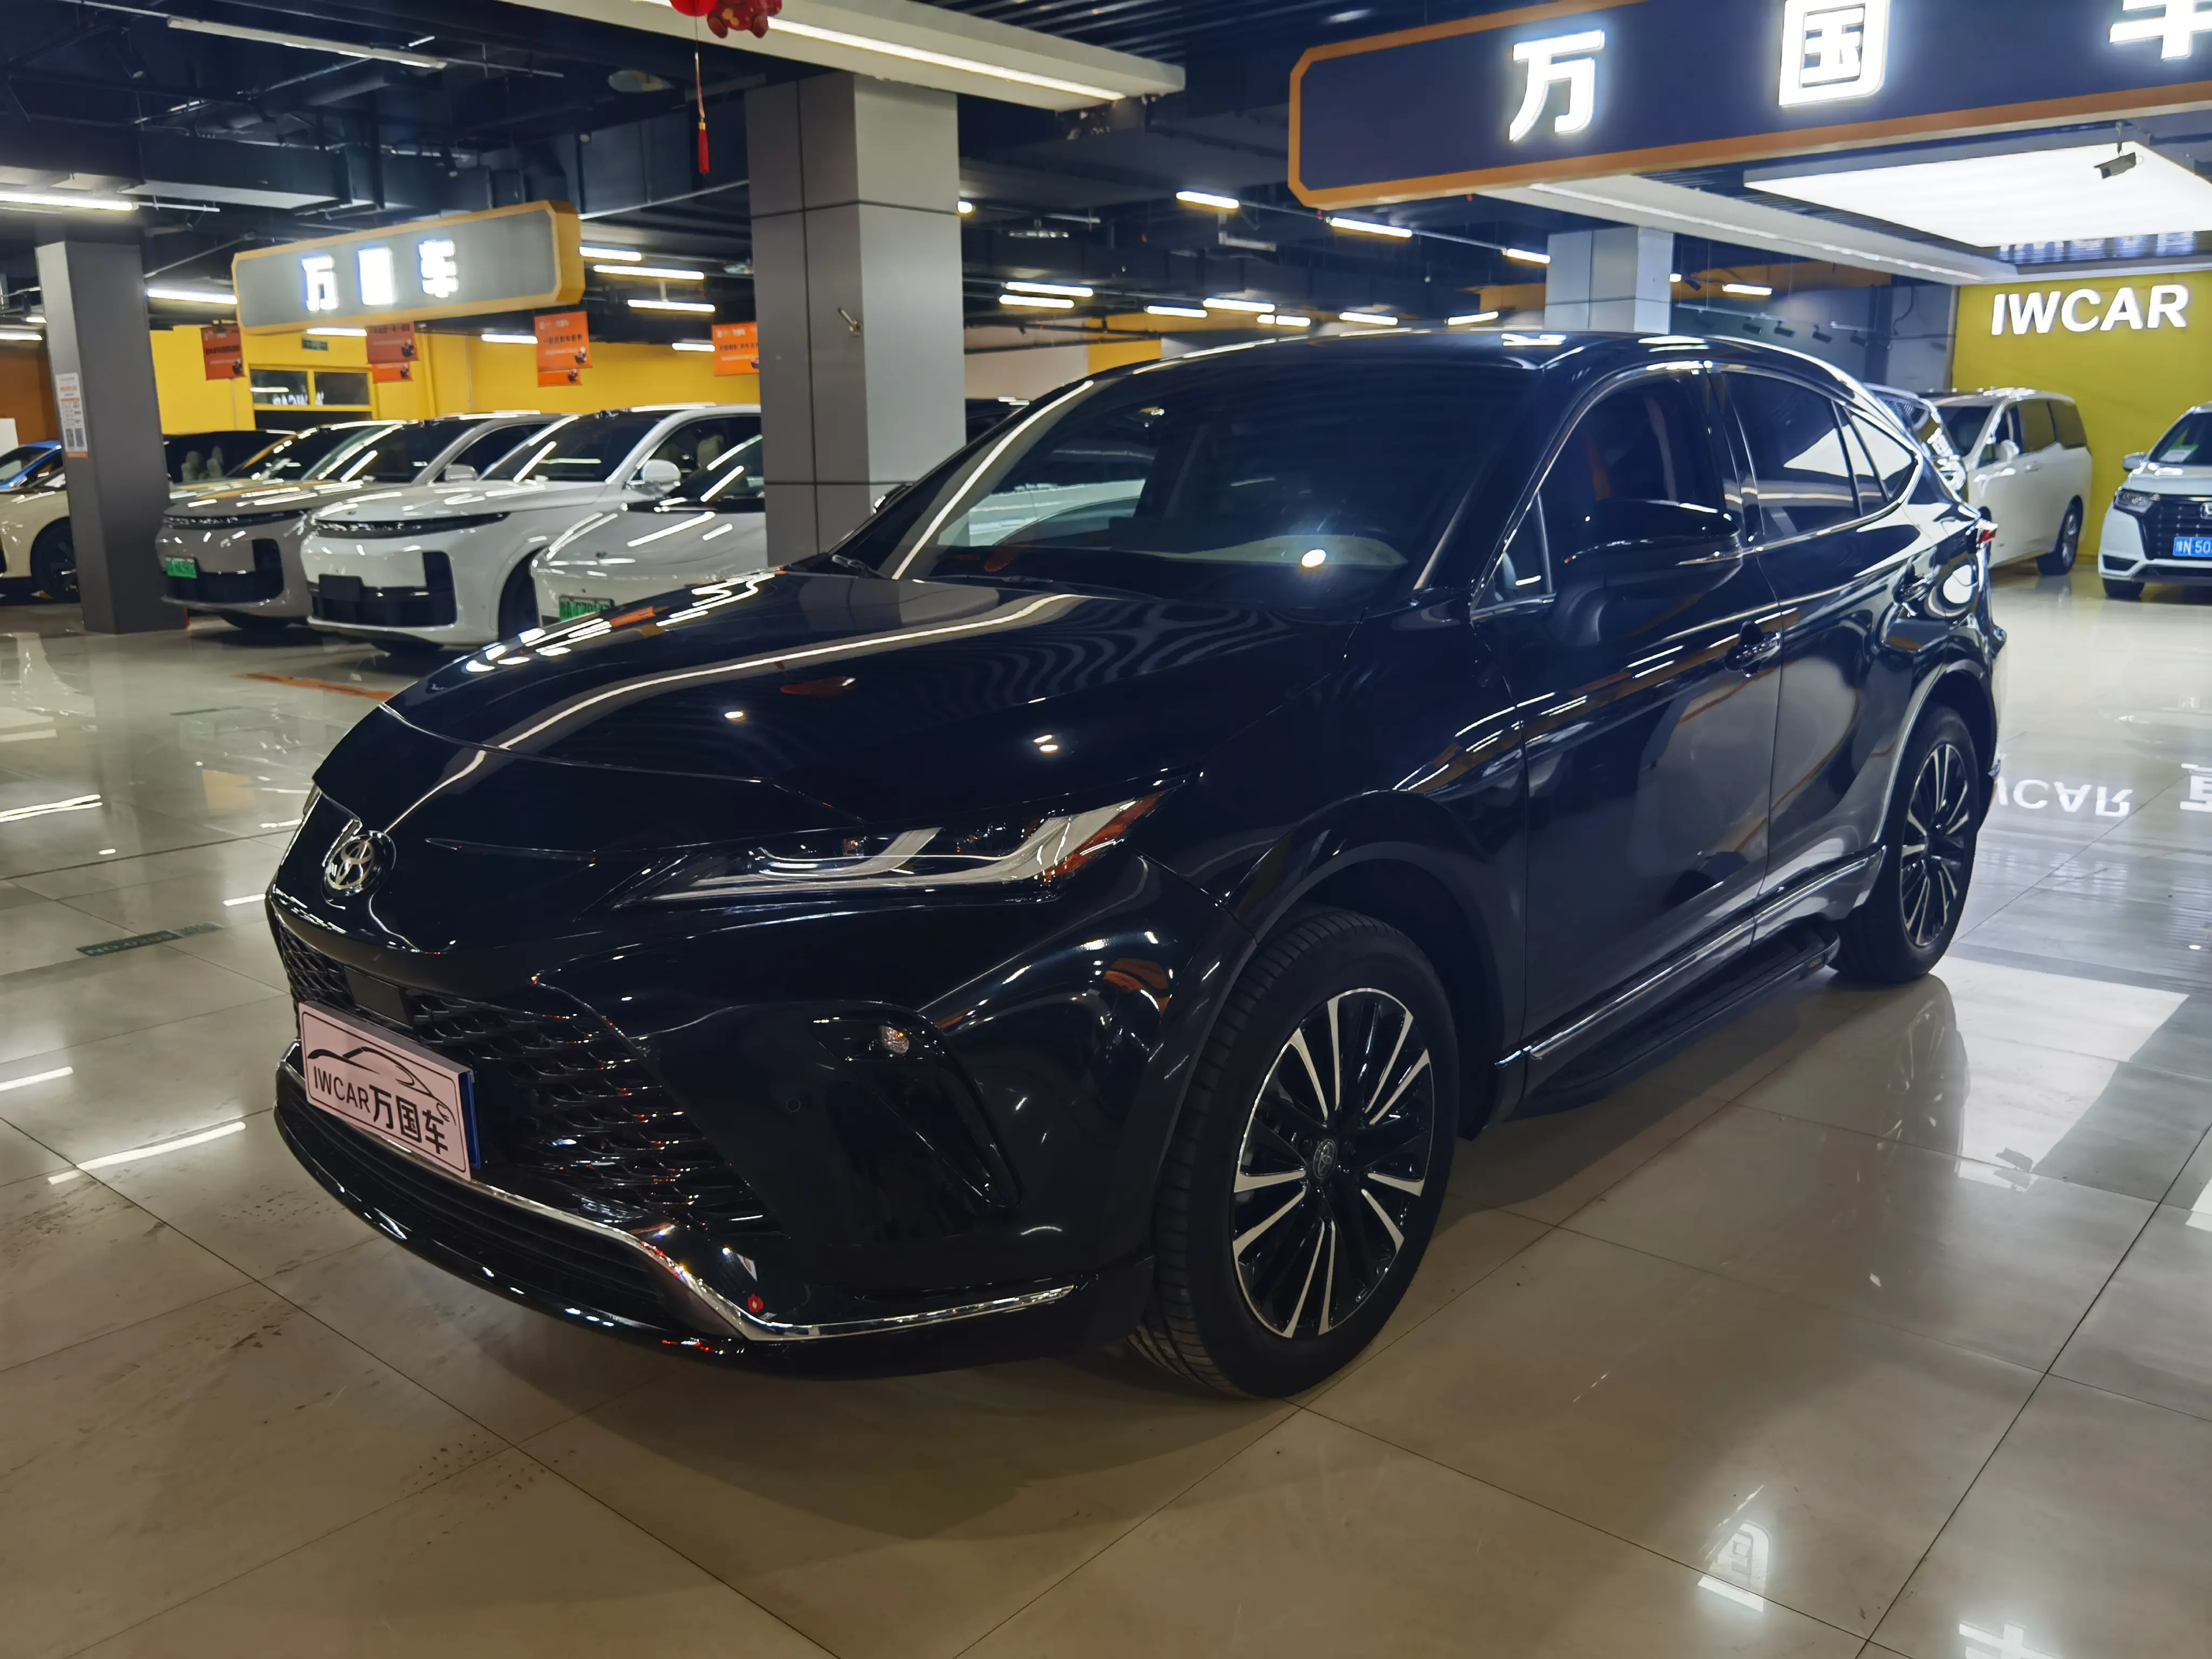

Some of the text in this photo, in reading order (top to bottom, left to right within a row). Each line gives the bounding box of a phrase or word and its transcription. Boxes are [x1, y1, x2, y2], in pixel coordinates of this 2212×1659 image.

[301, 239, 459, 312] 万车
[1991, 284, 2189, 336] IWCAR
[313, 1065, 448, 1155] IWCAR万国车
